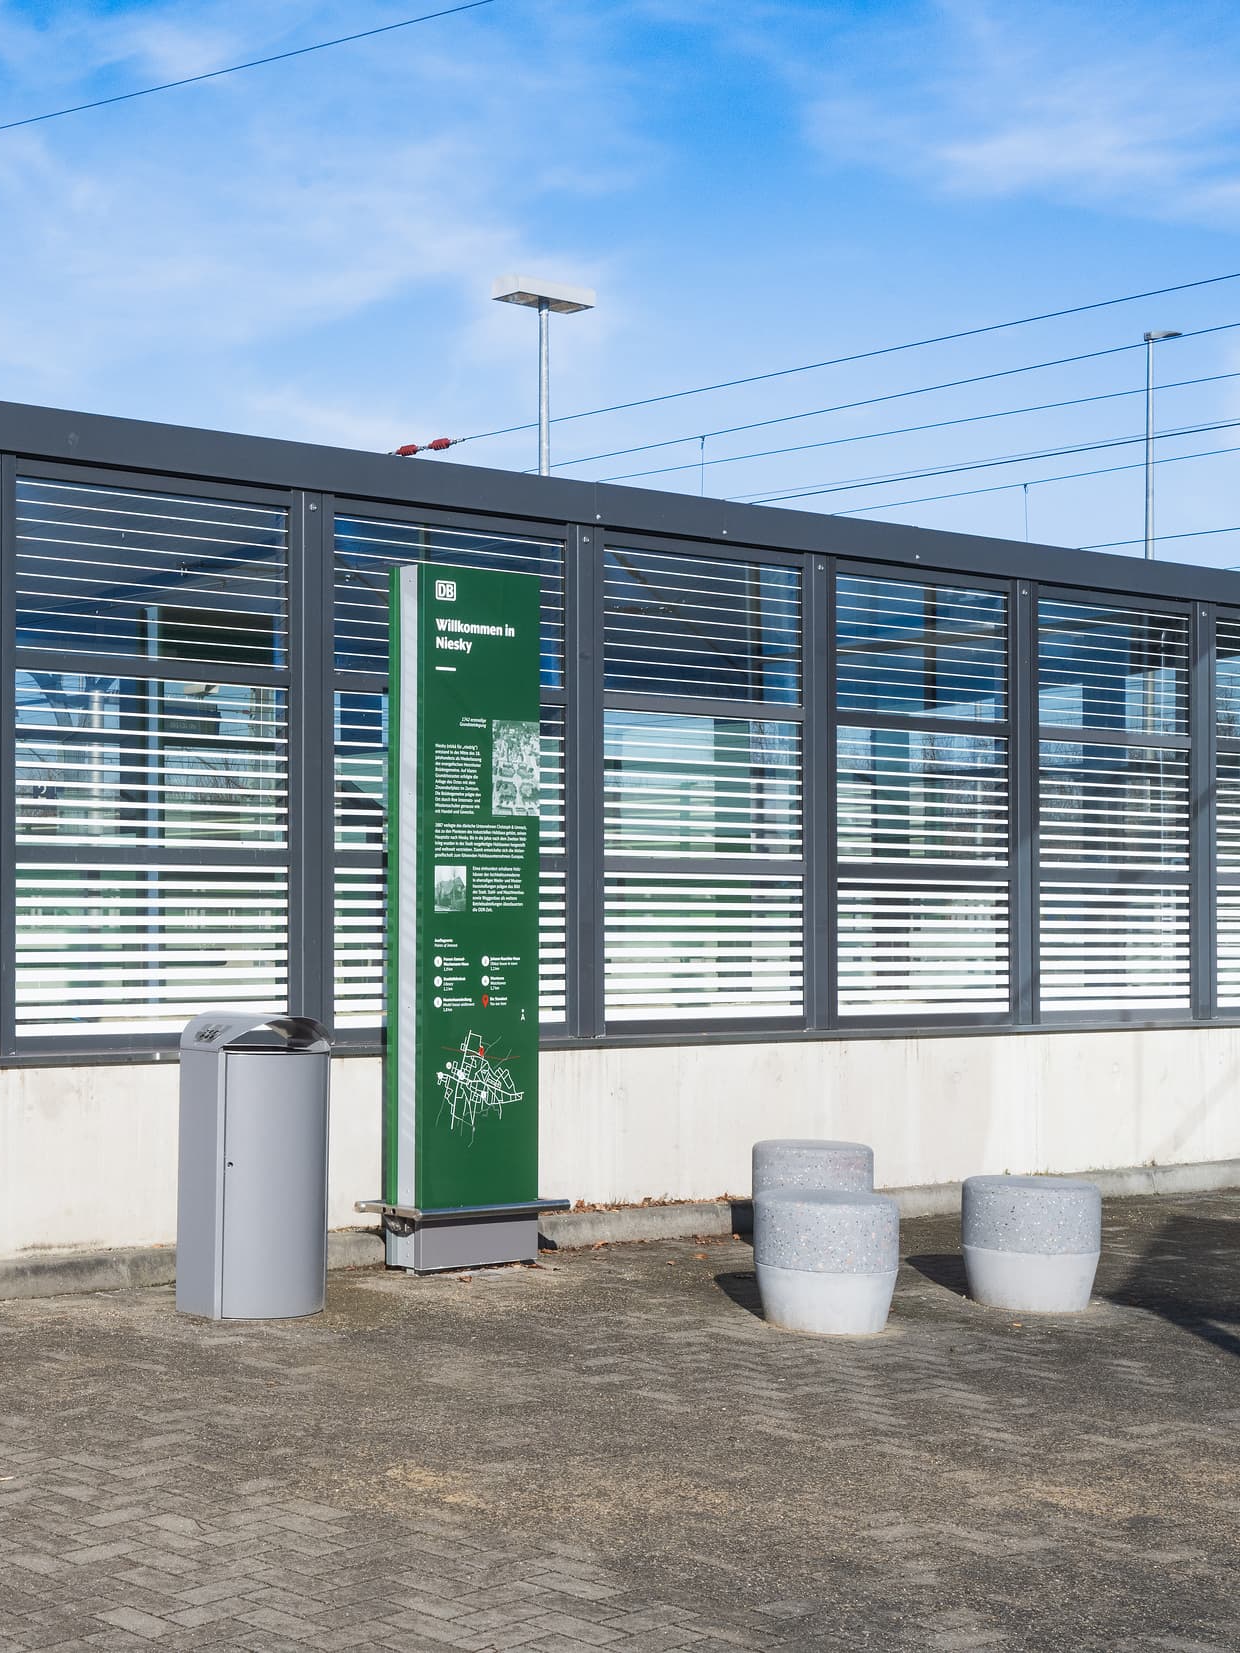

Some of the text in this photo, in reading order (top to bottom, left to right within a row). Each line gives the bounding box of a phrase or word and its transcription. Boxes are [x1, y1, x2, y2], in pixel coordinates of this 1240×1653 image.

[437, 583, 454, 598] DB
[435, 618, 516, 638] Willkommen in
[435, 636, 473, 654] Niesky
